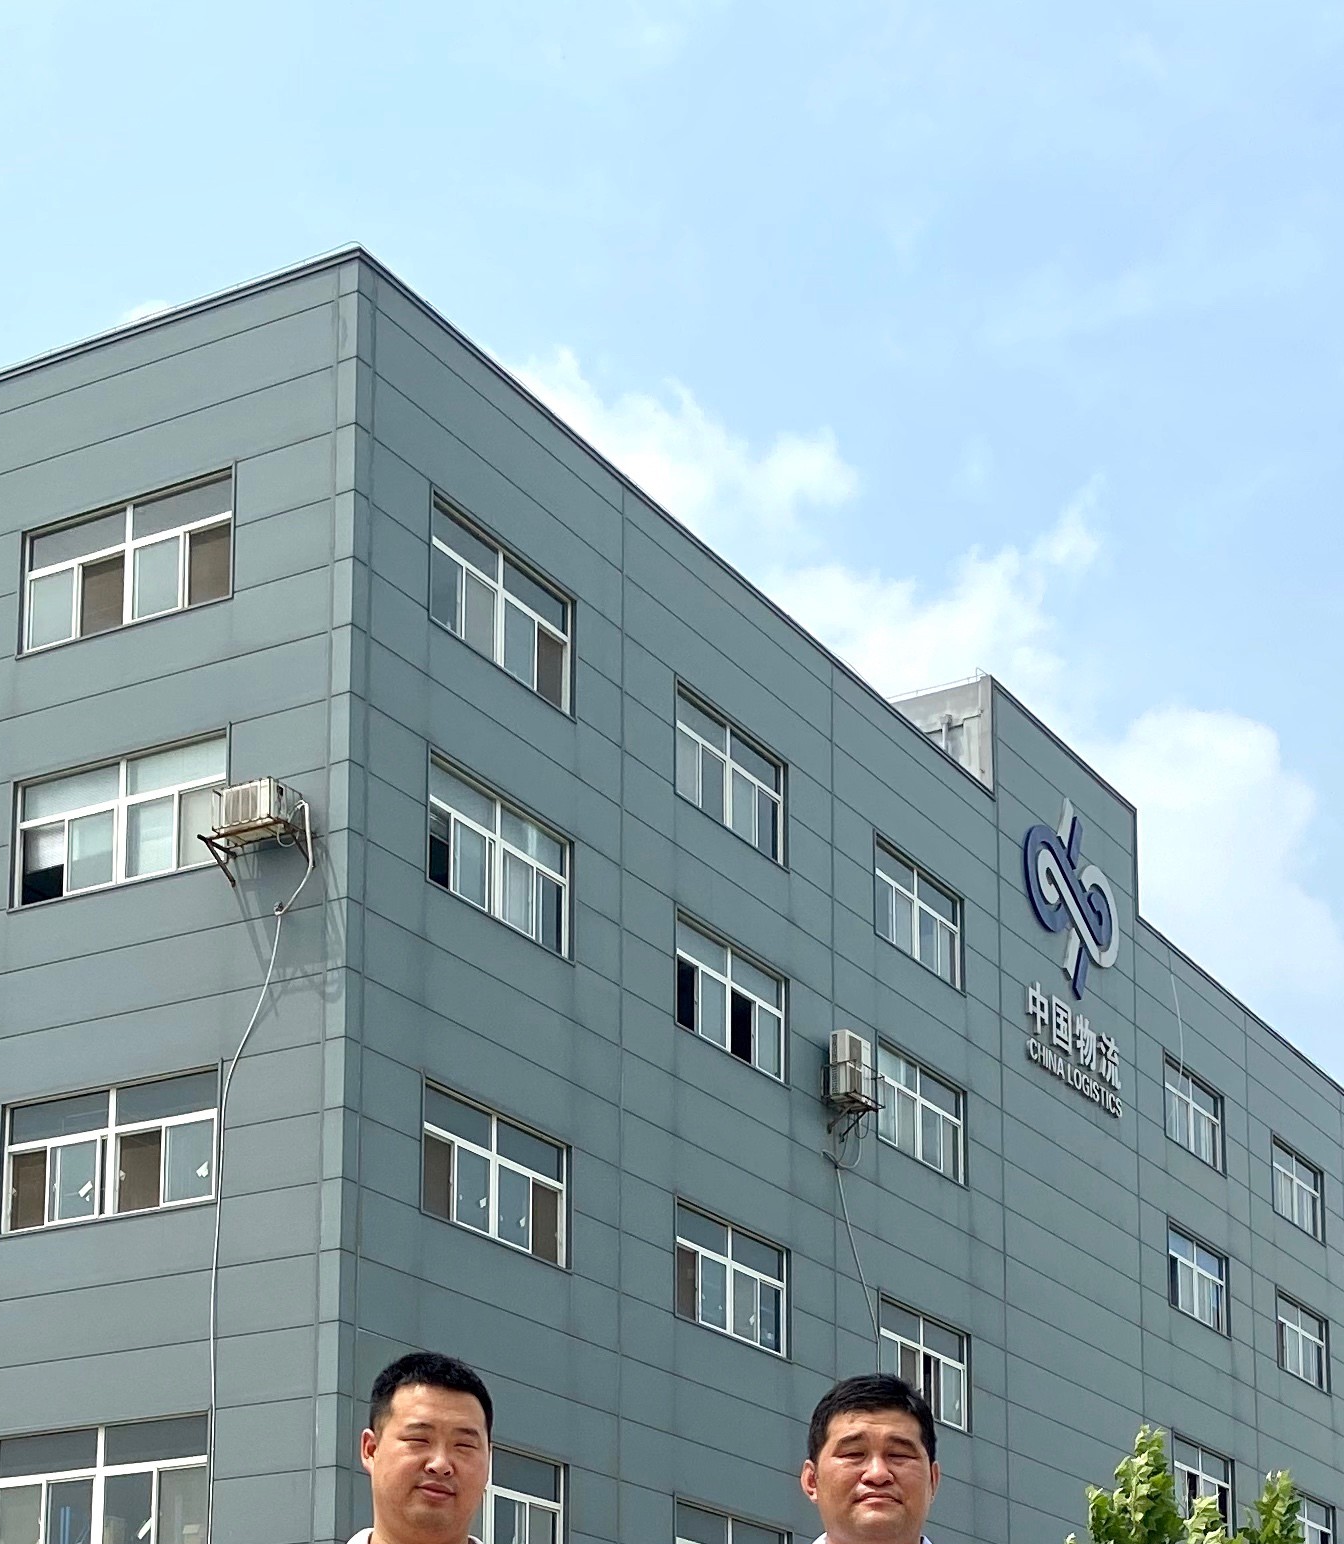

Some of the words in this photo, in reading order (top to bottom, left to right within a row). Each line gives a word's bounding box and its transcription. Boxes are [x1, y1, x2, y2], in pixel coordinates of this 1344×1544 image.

[1026, 1037, 1065, 1080] CHINA
[1067, 1063, 1123, 1118] LOGISTICS
[1028, 981, 1121, 1090] 中国物流
